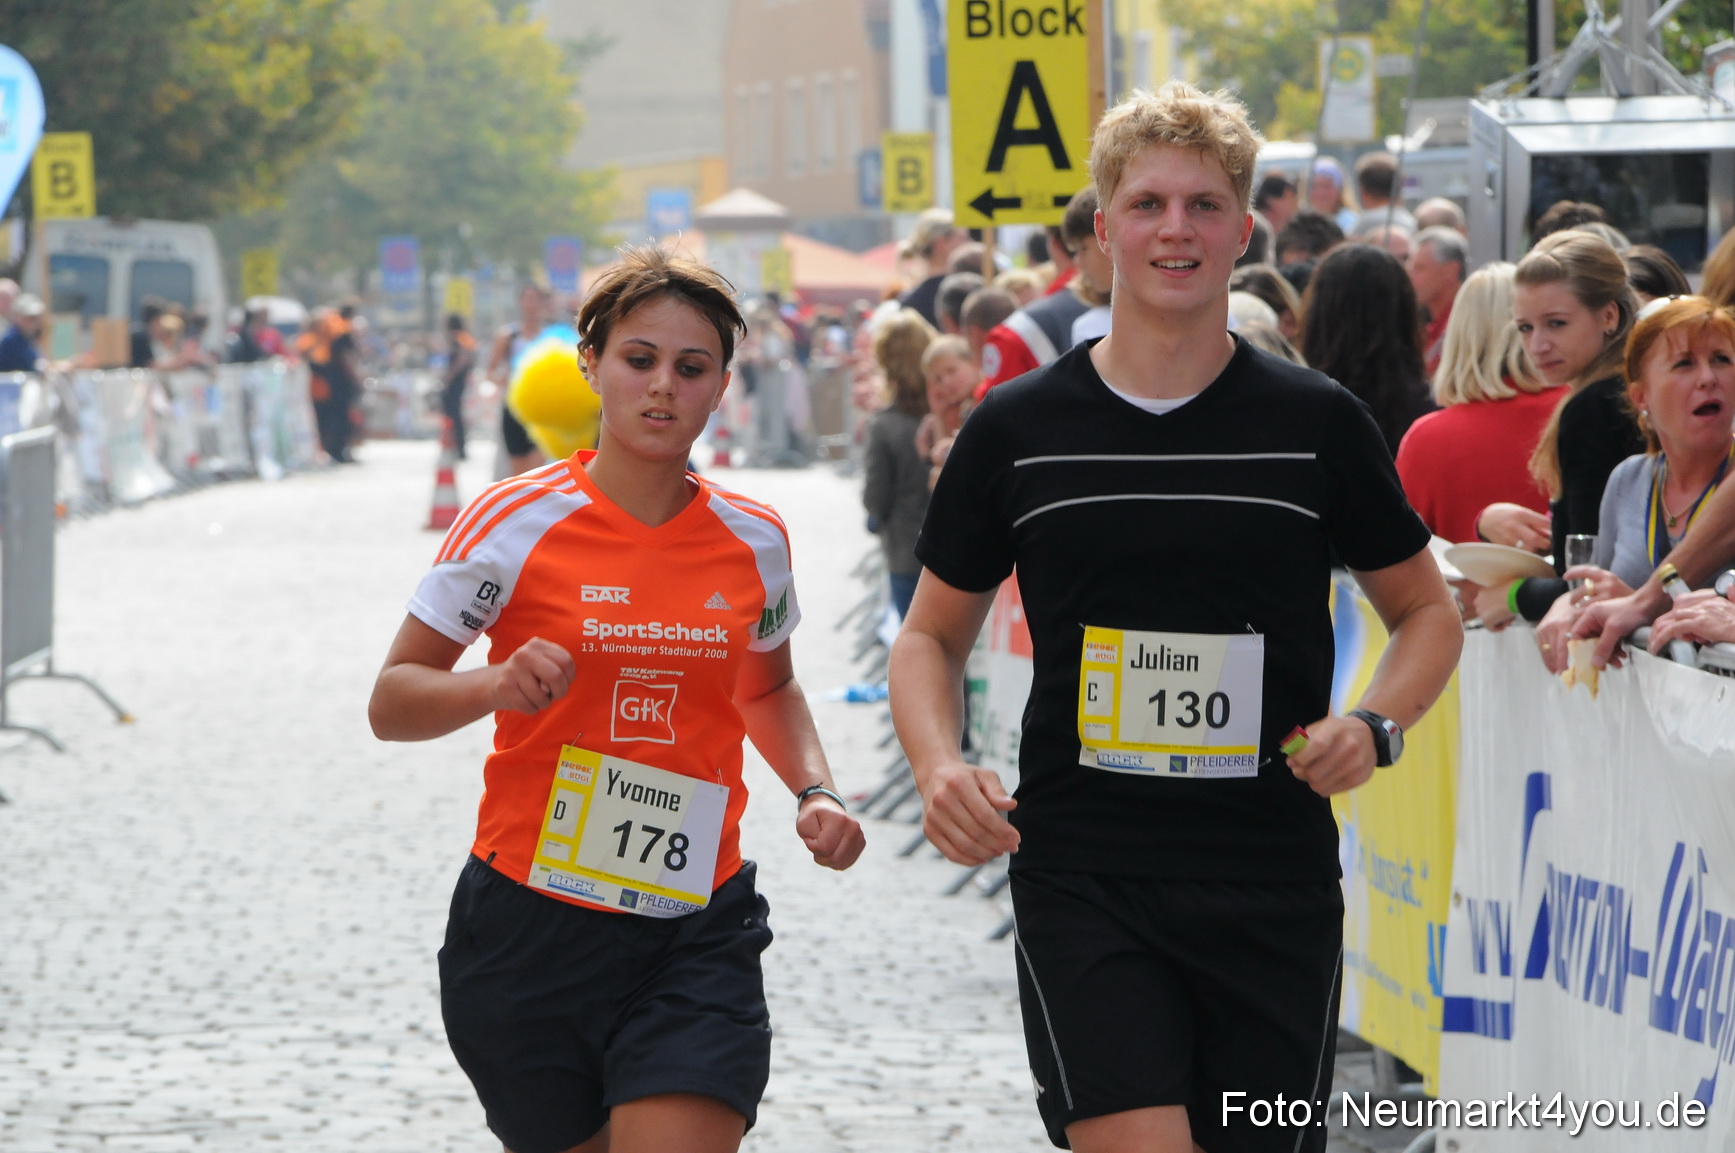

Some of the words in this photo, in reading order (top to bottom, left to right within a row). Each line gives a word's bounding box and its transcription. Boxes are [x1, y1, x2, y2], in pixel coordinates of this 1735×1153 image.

[966, 0, 1085, 38] Block
[986, 60, 1072, 172] A
[50, 161, 78, 200] B
[897, 157, 922, 195] B
[476, 580, 501, 606] BR
[580, 584, 631, 605] DAK
[582, 618, 729, 644] SportScheck
[581, 642, 598, 653] 13.
[602, 643, 656, 656] Nürnberger
[659, 645, 703, 658] Stadtlauf
[704, 648, 728, 660] 2008
[1130, 643, 1199, 672] Julian
[1087, 682, 1098, 702] C
[620, 696, 666, 723] GfK
[1148, 689, 1231, 729] 130
[1189, 754, 1256, 768] PFLEIDERER
[606, 767, 682, 813] Yvonne
[553, 800, 567, 821] D
[613, 819, 690, 872] 178
